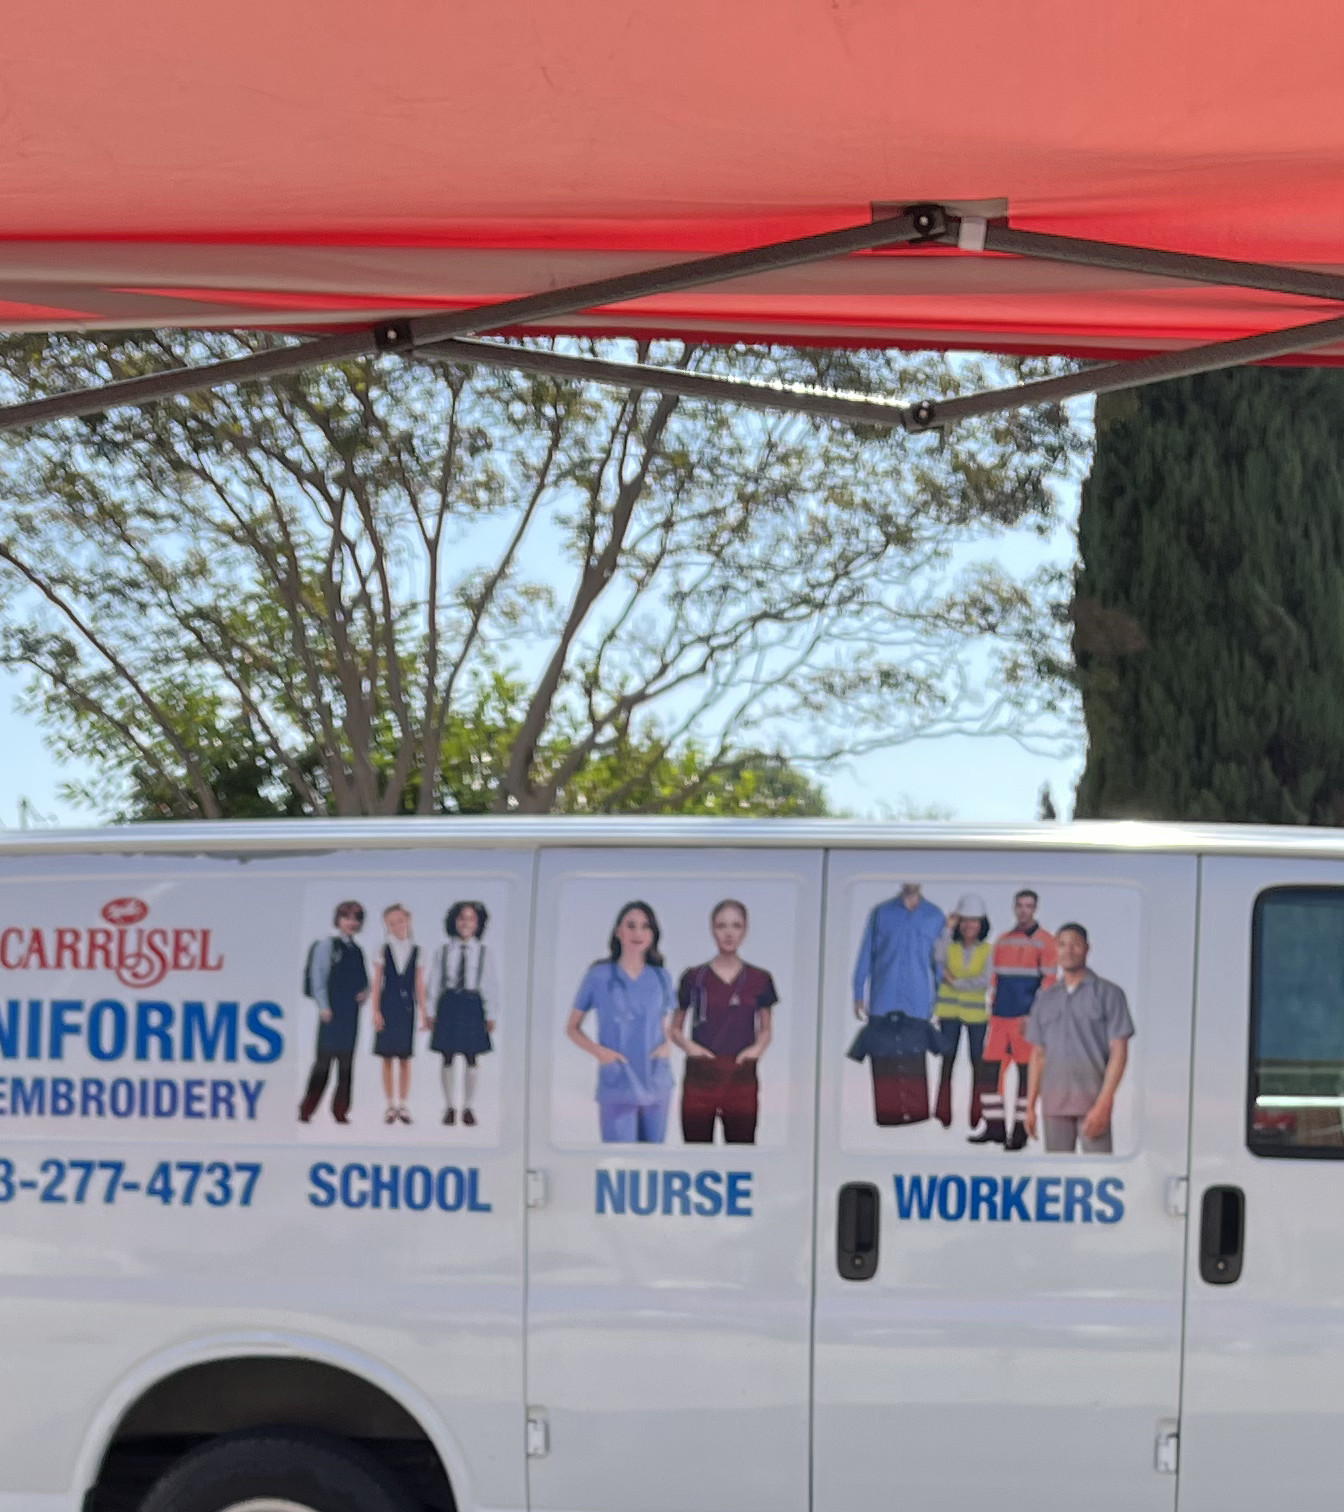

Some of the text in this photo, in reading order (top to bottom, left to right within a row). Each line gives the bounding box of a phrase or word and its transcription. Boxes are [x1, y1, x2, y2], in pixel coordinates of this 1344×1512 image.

[0, 927, 225, 988] CARRUSEL
[309, 1163, 492, 1213] SCHOOL
[595, 1169, 753, 1217] NURSE
[894, 1174, 1126, 1224] WORKERS
